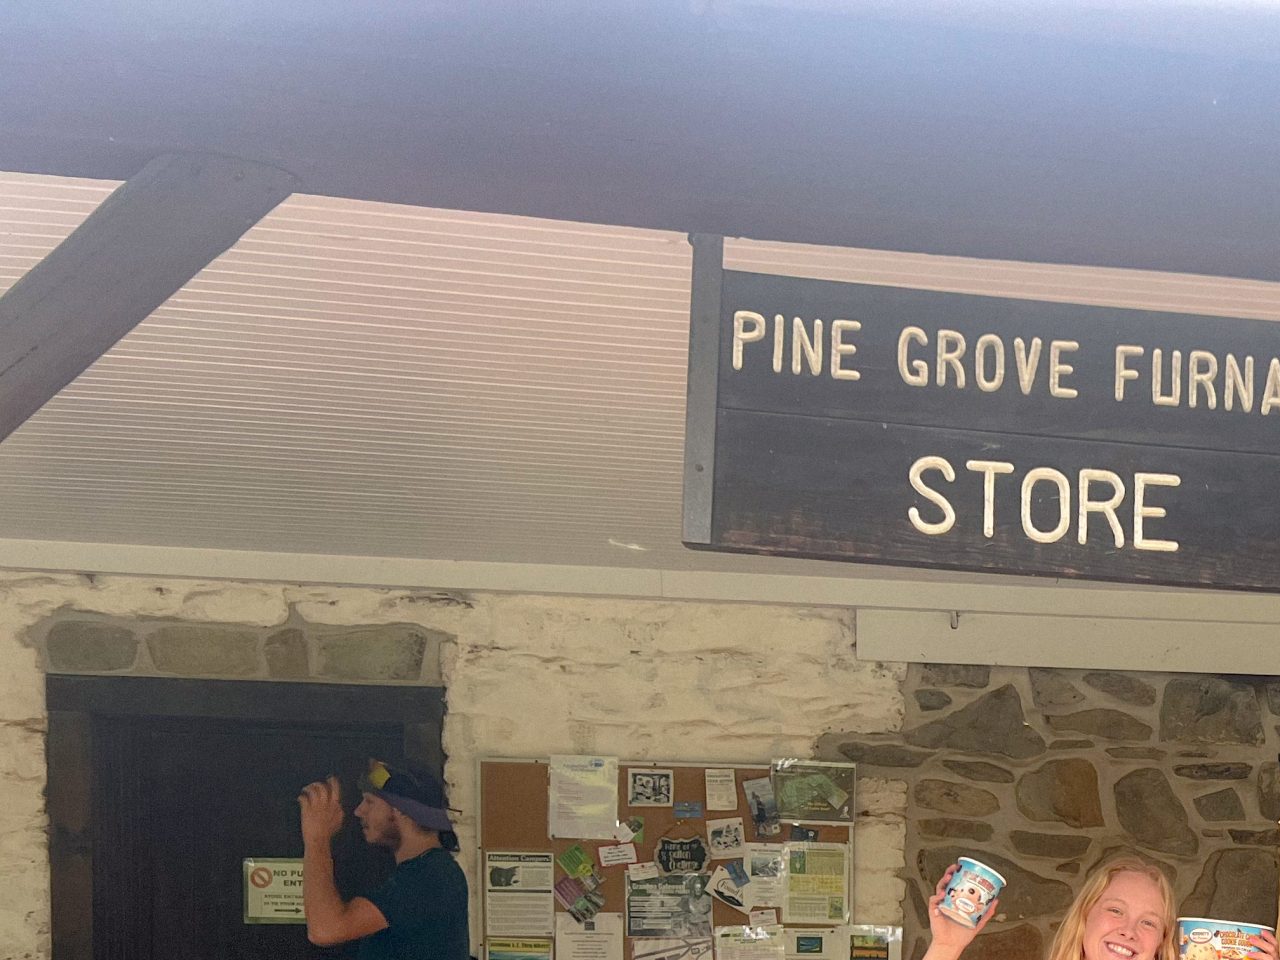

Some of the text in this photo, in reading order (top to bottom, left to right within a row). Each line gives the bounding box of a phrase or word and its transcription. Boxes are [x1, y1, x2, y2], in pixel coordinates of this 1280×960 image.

[731, 309, 862, 382] PINE
[896, 325, 1081, 400] GROVE
[906, 454, 1182, 553] STORE
